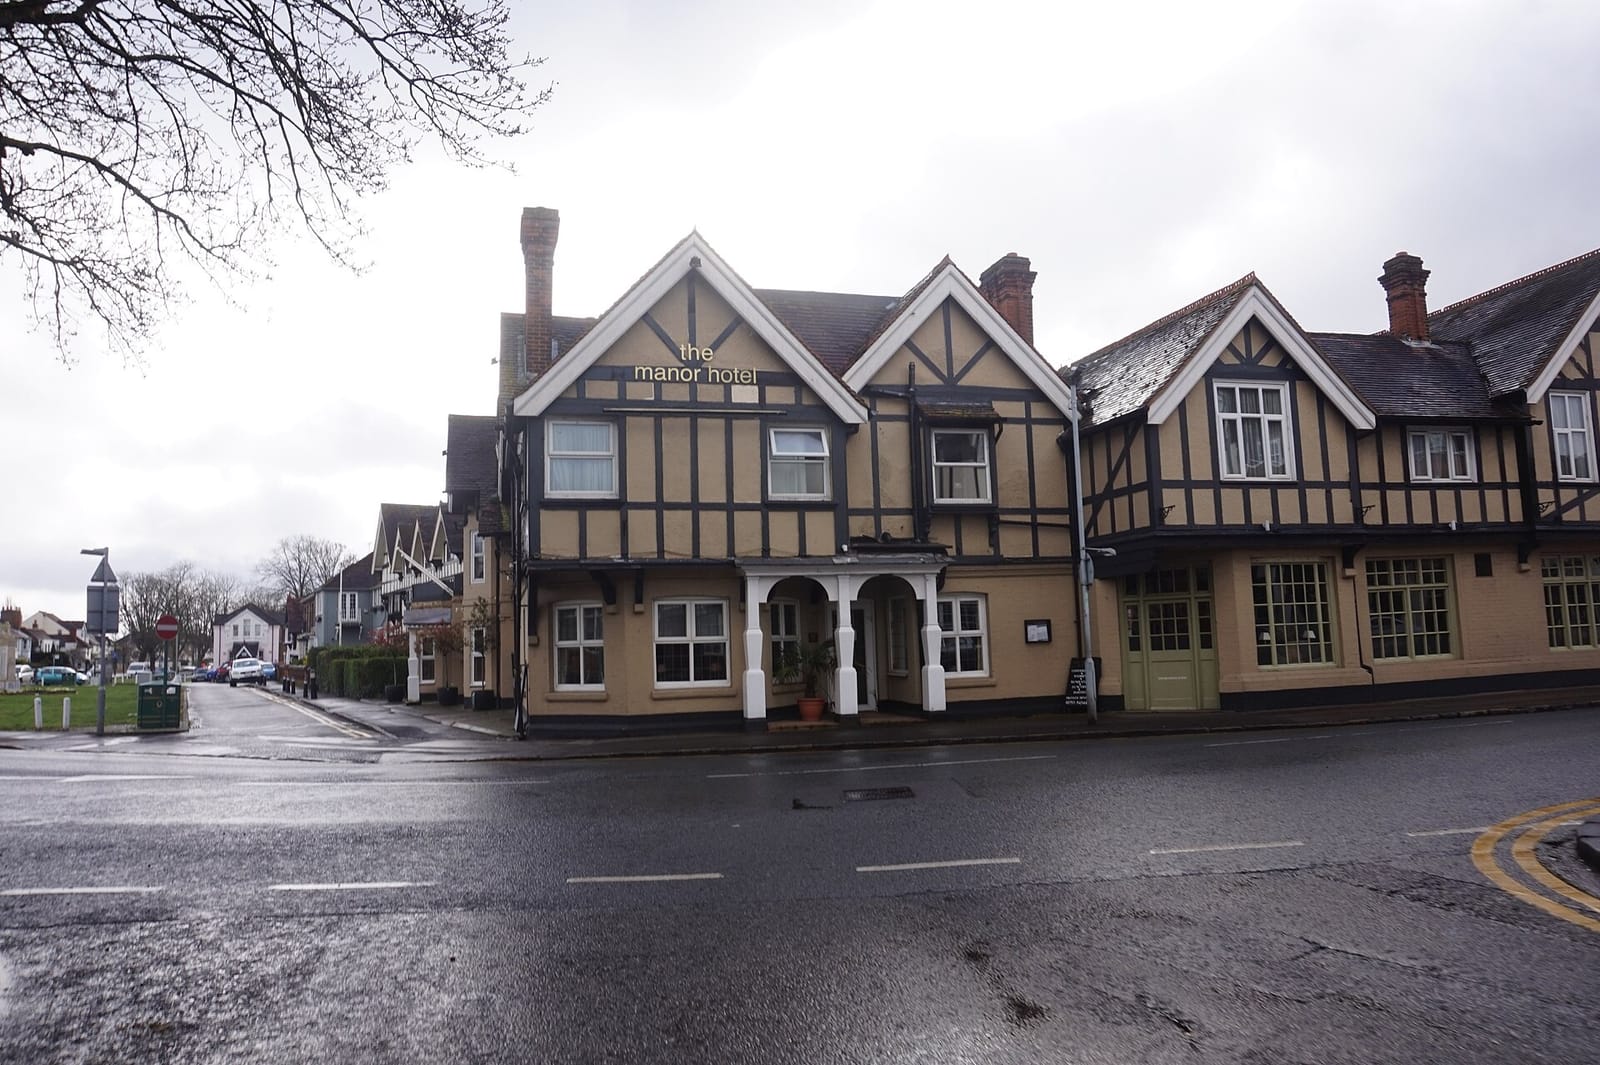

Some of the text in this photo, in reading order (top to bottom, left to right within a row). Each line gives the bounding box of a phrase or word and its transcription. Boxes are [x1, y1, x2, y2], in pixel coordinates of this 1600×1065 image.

[680, 343, 714, 361] the
[634, 365, 757, 384] manor hotel
